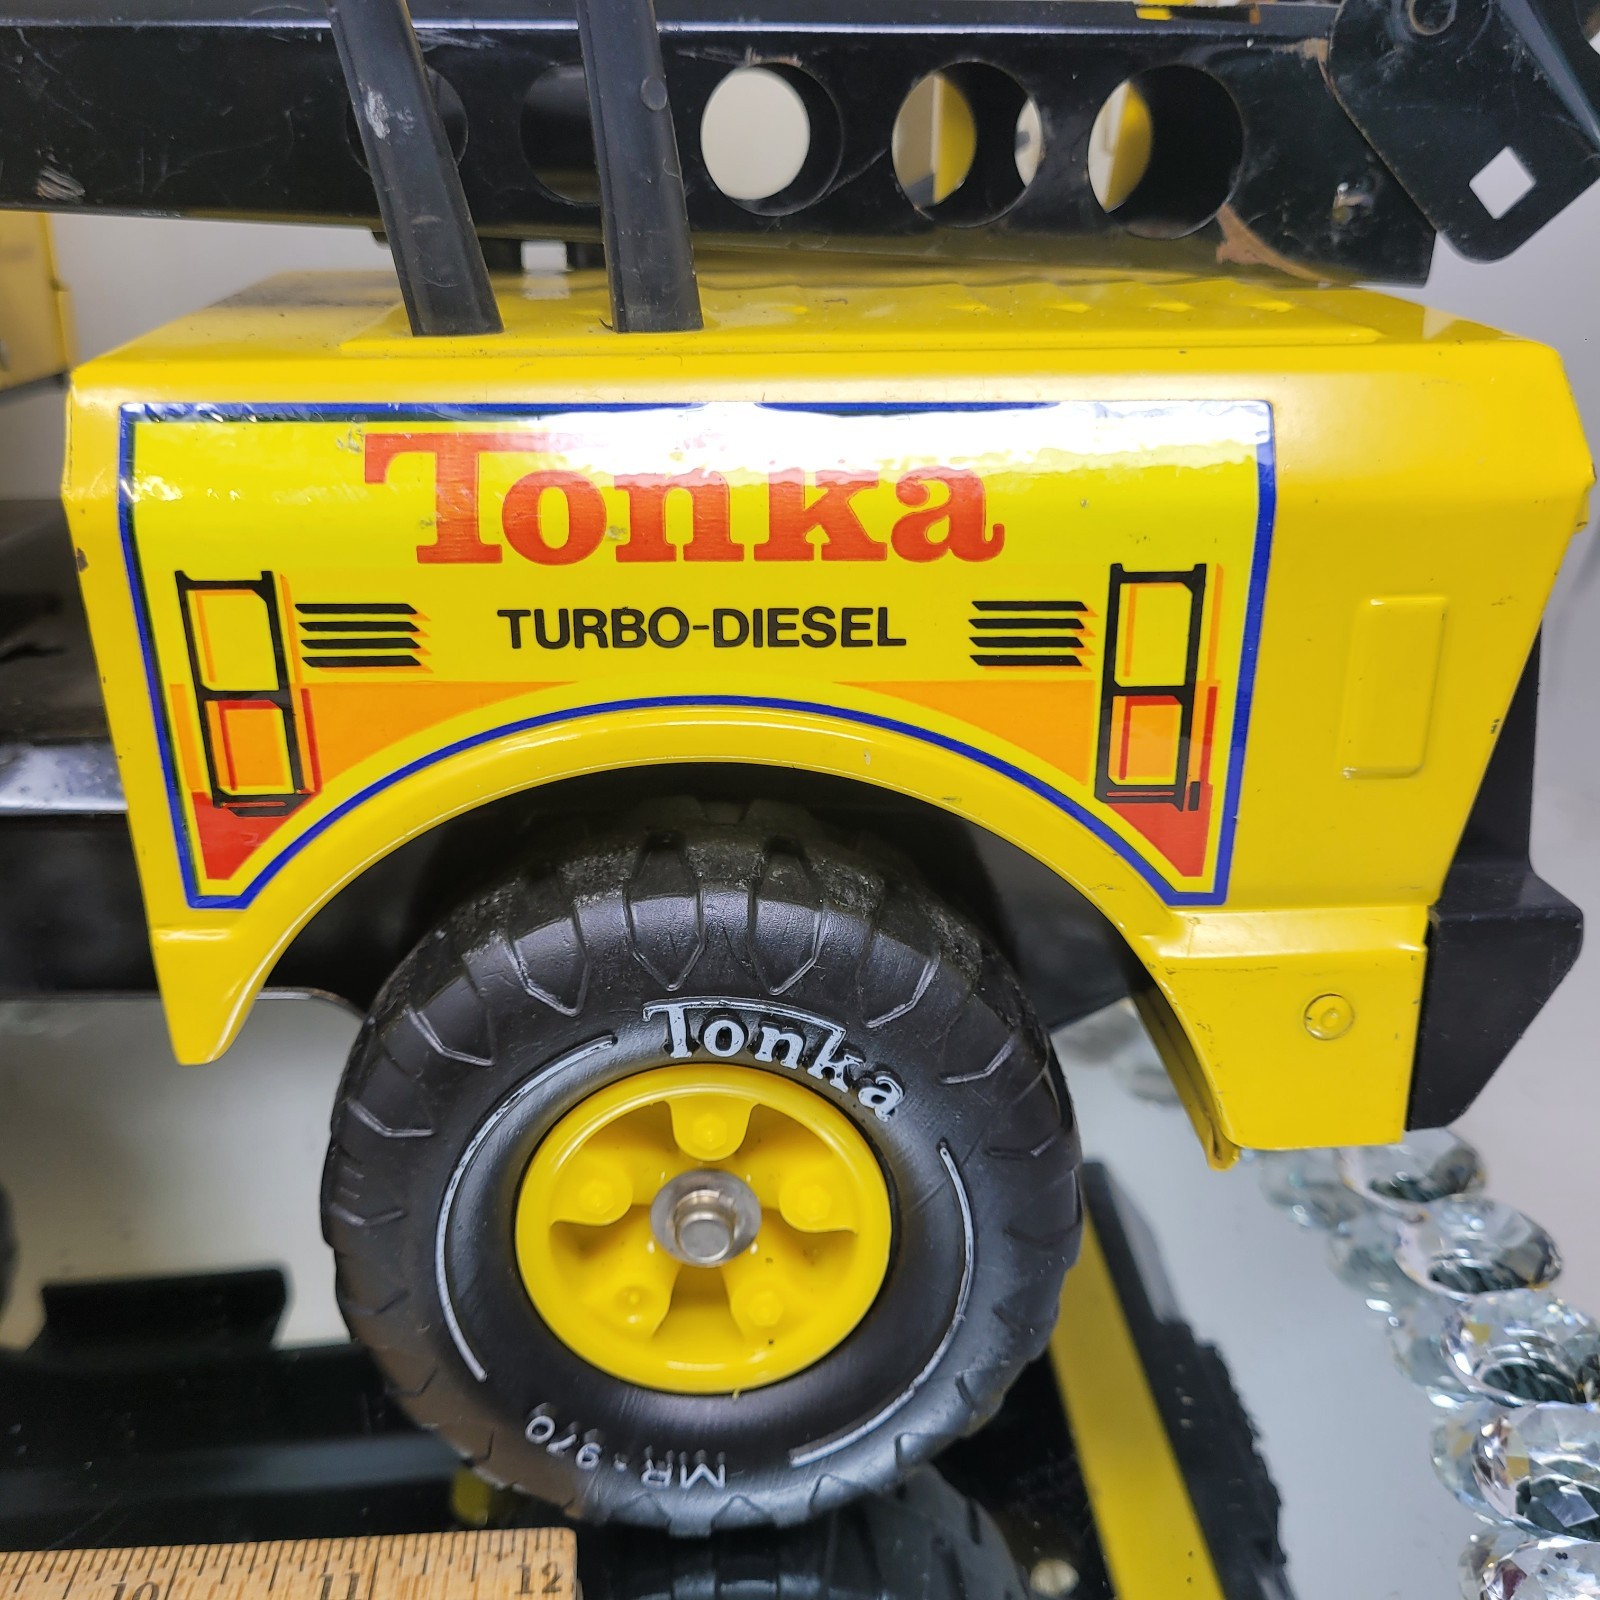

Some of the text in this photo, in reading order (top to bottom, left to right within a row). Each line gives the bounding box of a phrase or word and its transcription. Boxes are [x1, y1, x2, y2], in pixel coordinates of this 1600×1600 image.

[364, 432, 1006, 566] Tonka
[497, 606, 907, 650] TURBO-DIESEL
[642, 996, 905, 1123] Tonka
[110, 1561, 563, 1600] 10 11 12
